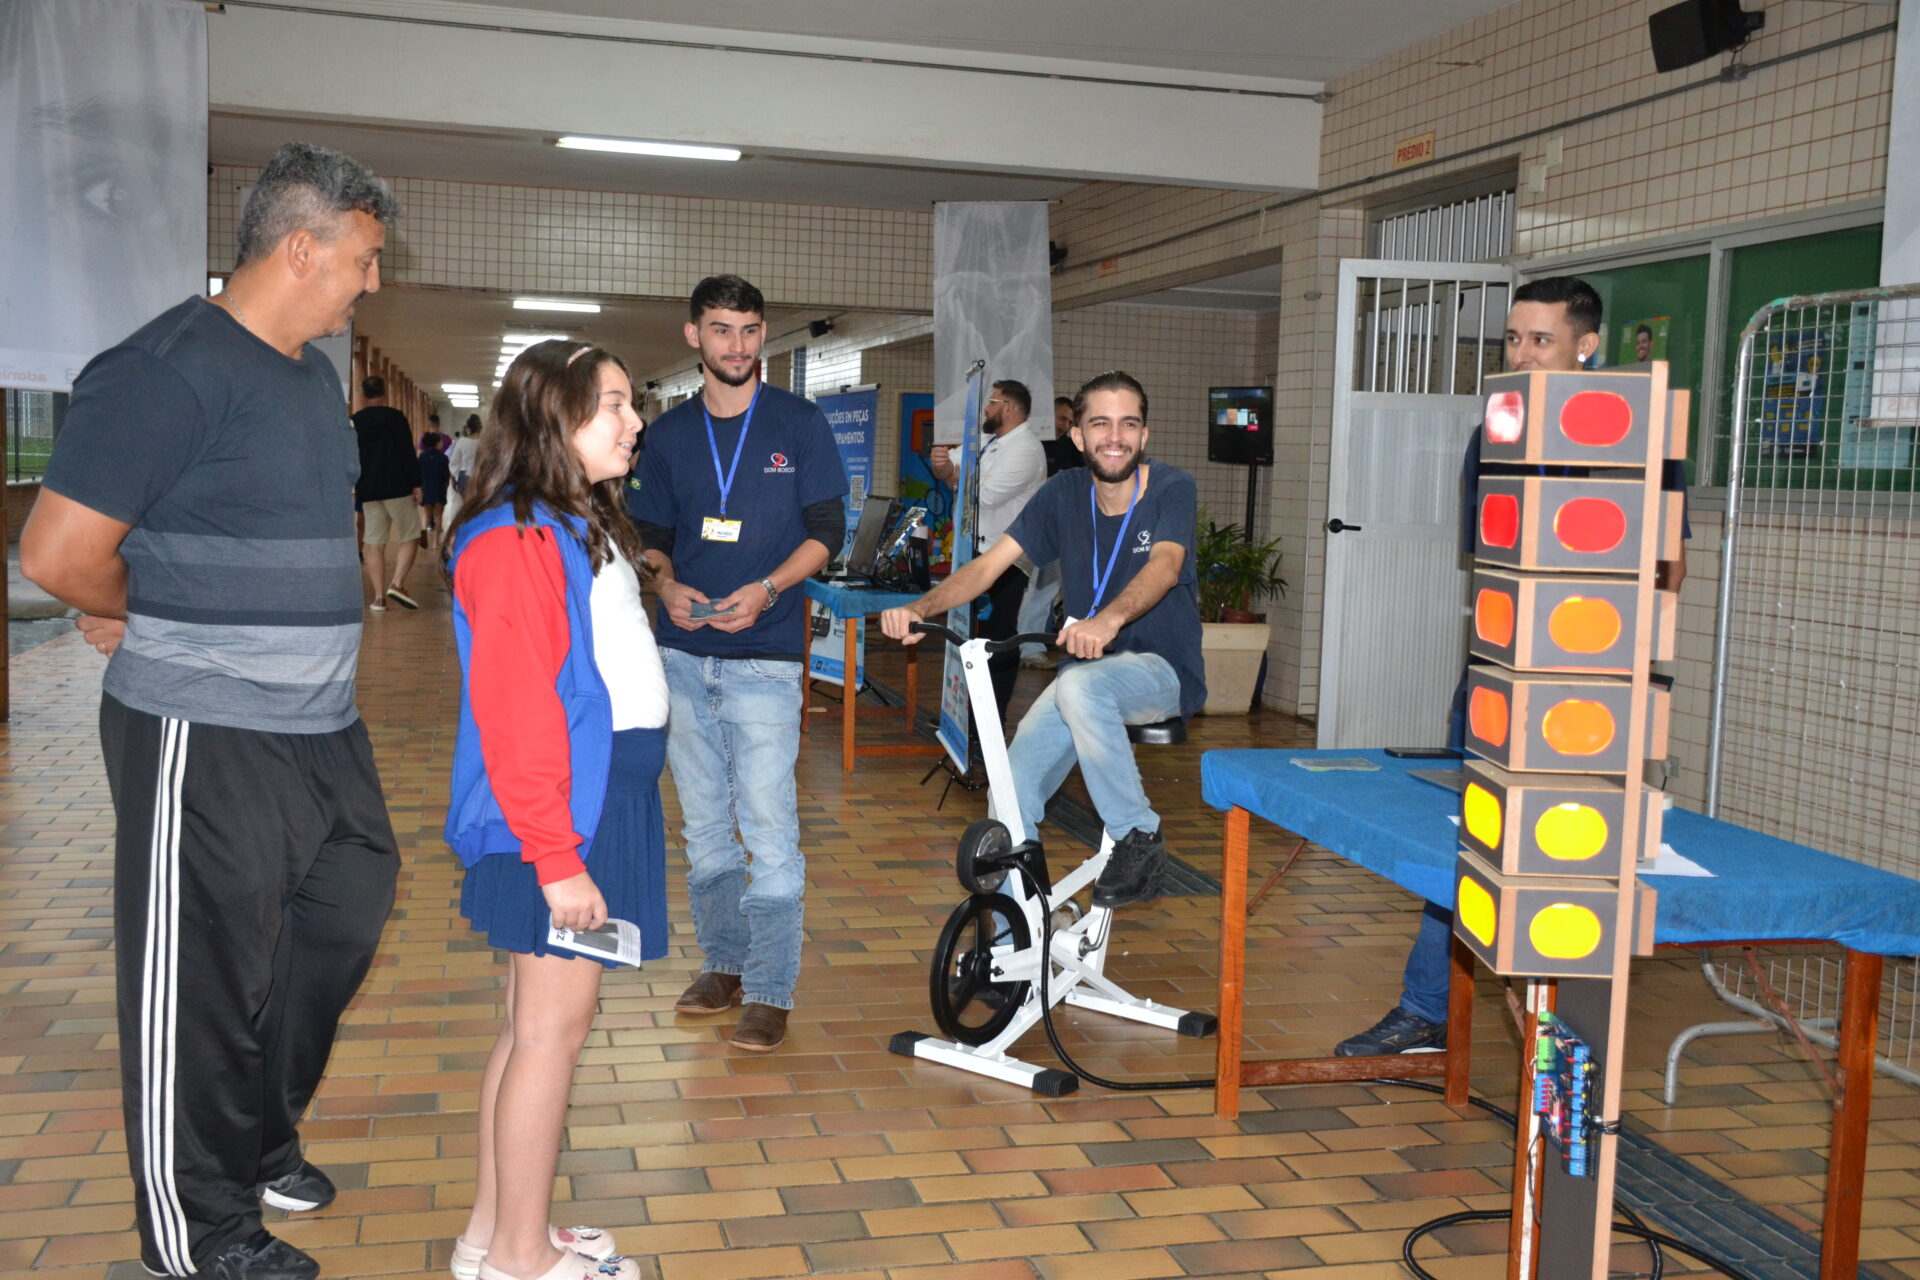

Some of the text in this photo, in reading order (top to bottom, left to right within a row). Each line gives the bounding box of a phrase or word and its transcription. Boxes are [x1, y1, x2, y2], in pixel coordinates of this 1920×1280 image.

[1397, 140, 1431, 163] PRÉDIO 2
[853, 409, 869, 426] PEÇAS
